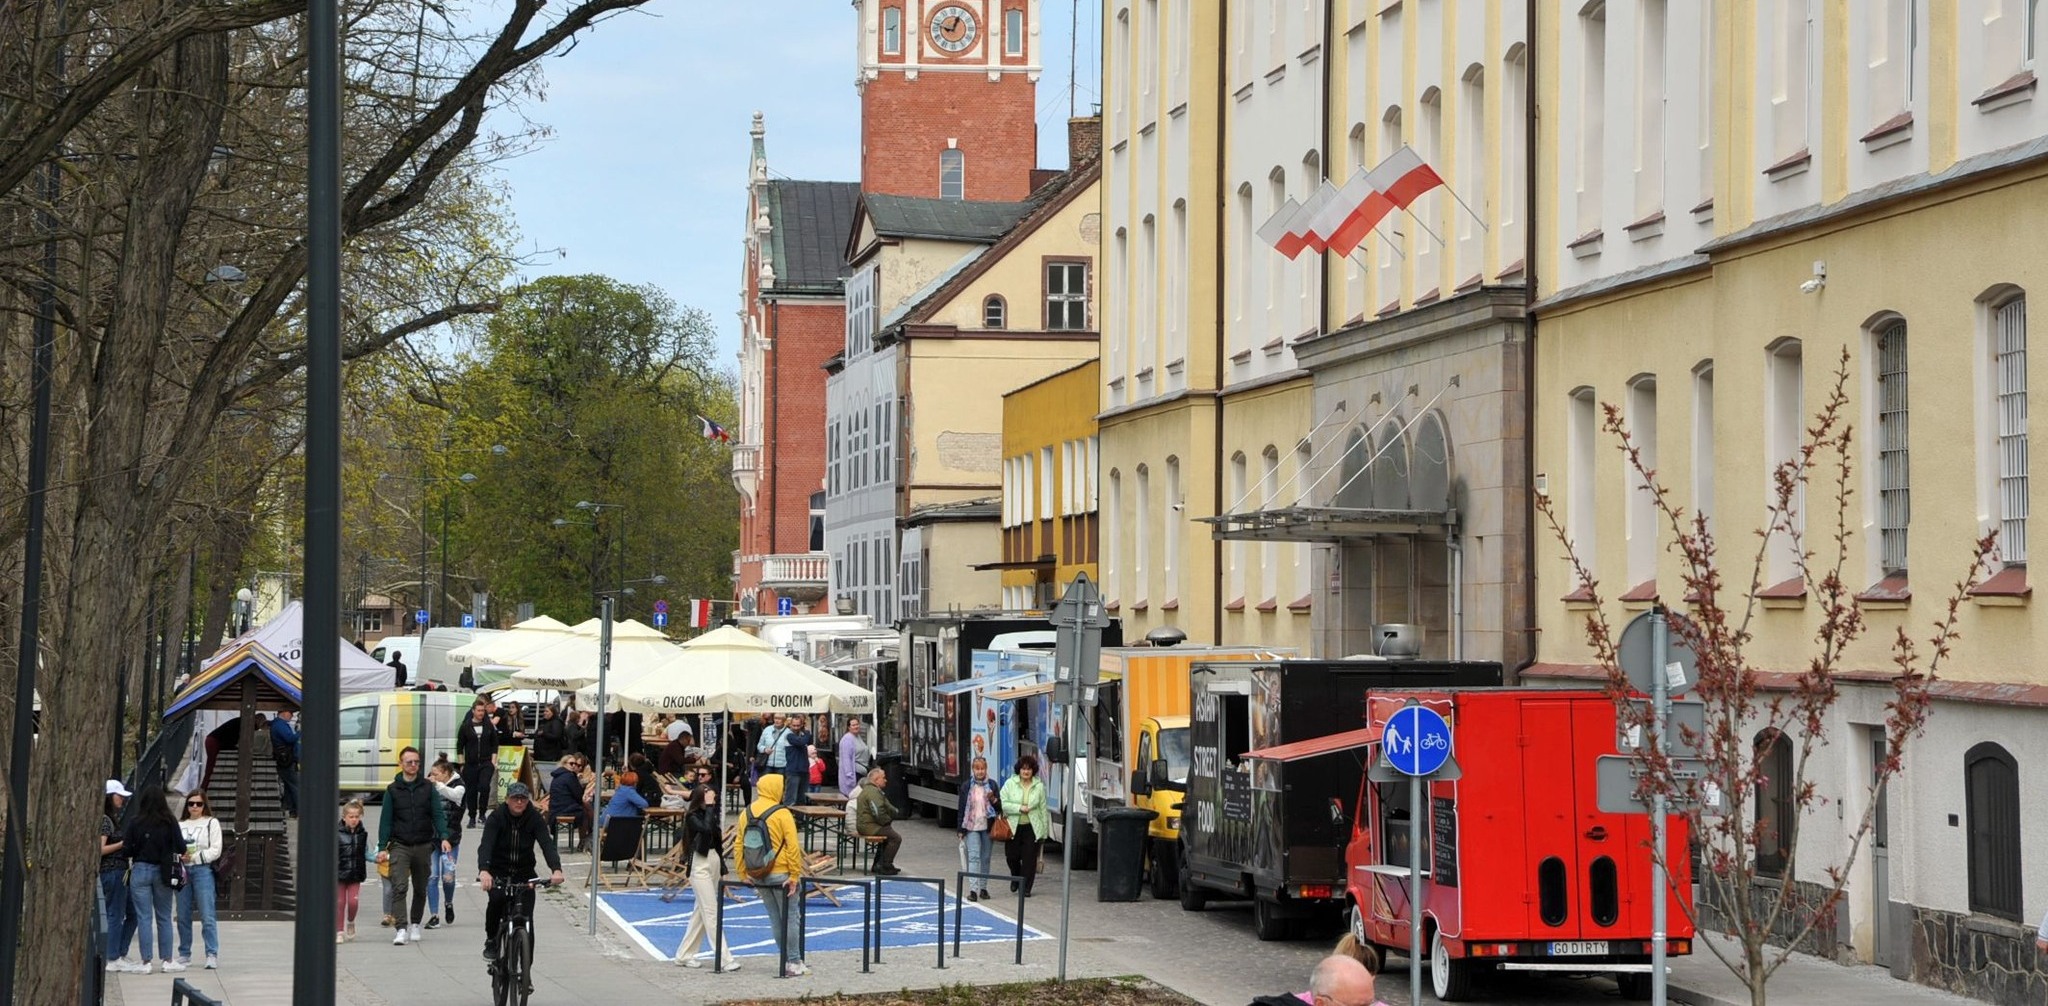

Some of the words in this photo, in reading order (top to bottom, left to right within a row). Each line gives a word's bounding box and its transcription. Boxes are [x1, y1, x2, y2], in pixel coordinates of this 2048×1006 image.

[464, 615, 473, 626] P
[279, 649, 301, 661] KO
[663, 695, 705, 708] OKOCIM
[770, 694, 813, 708] OKOCIM
[1196, 692, 1216, 722] ASIAN
[1194, 746, 1217, 778] STREET
[1198, 800, 1215, 833] FOOD
[1571, 942, 1606, 953] DIRTY
